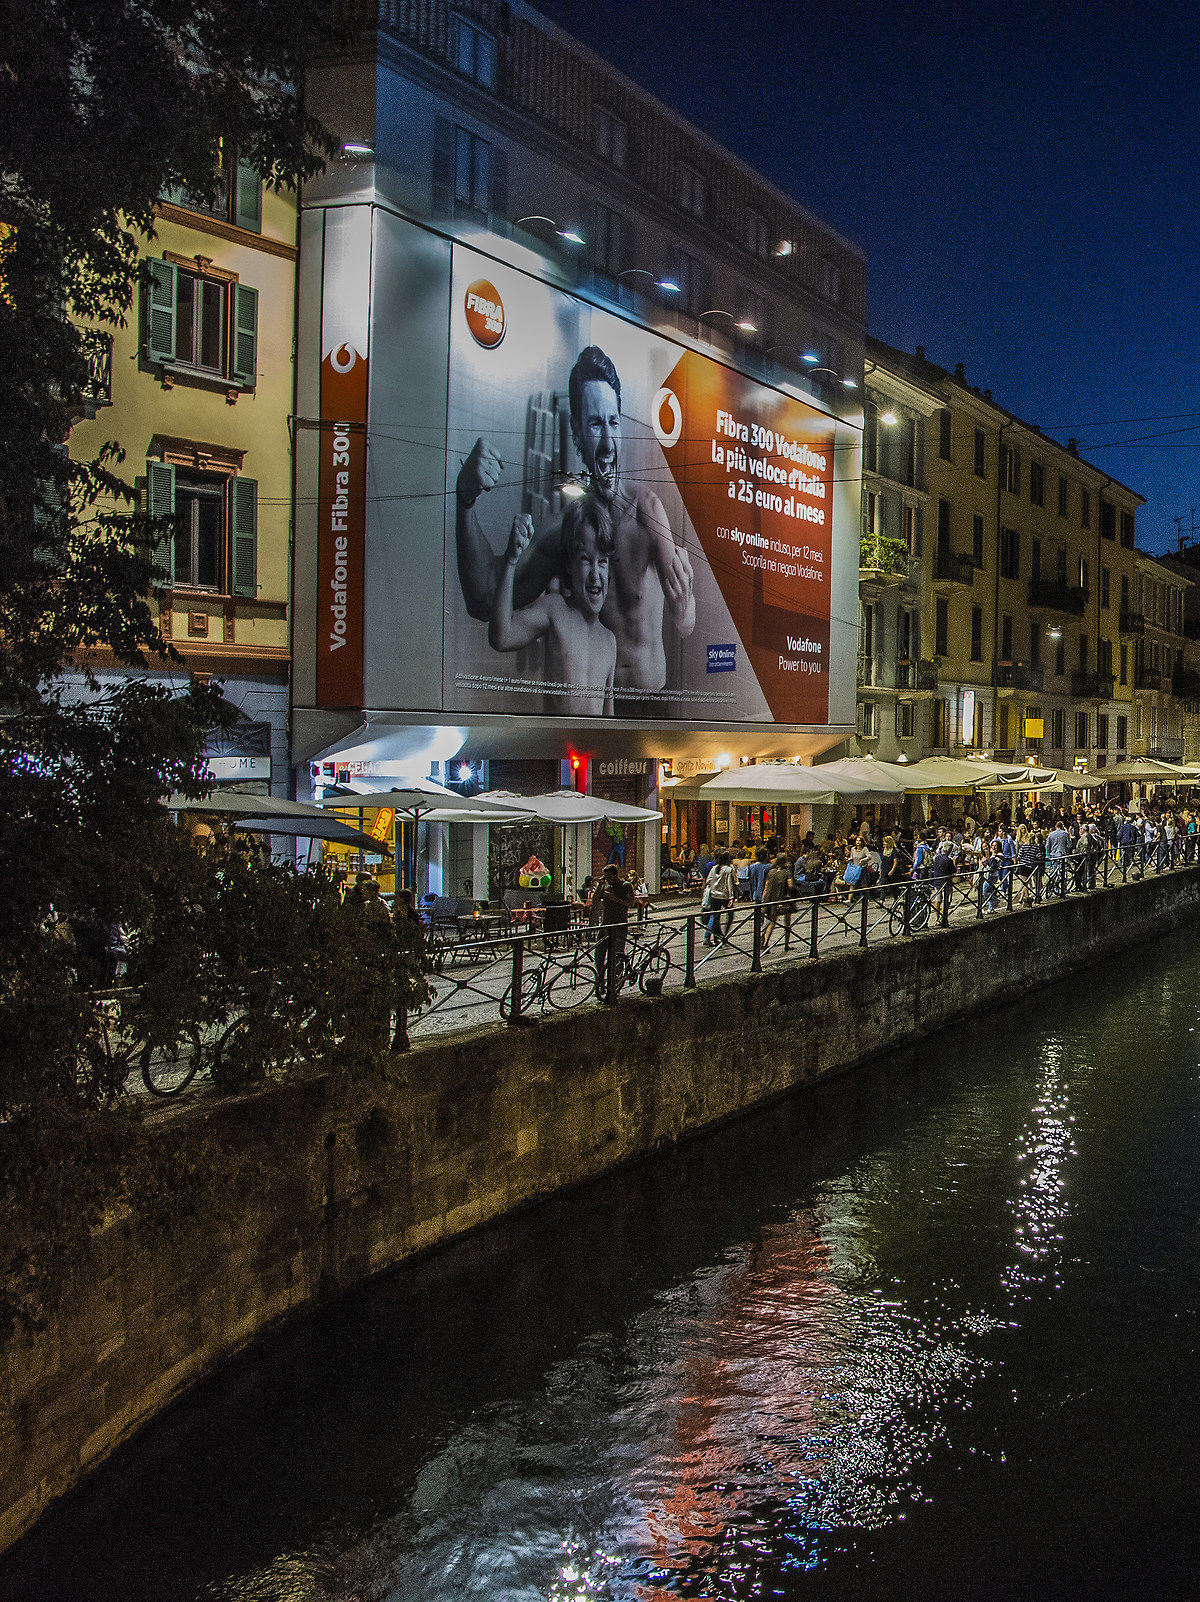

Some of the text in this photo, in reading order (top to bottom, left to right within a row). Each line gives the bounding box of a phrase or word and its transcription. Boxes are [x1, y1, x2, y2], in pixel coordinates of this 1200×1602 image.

[467, 292, 503, 323] FIBRA
[485, 317, 503, 334] 300
[716, 409, 827, 472] Fibra 300 Vodafone
[711, 439, 826, 499] la più veloce d'Italia
[727, 479, 825, 525] a 25 euro al mese
[330, 423, 350, 652] Vodafone Fibra 300
[716, 526, 730, 540] con
[730, 527, 745, 547] sky
[745, 533, 770, 550] online
[791, 545, 802, 559] per
[802, 546, 810, 560] 12
[777, 562, 797, 578] negozi
[708, 648, 719, 661] sky
[786, 635, 822, 654] Vodafone
[778, 655, 821, 676] Power to you
[217, 757, 256, 769] OME
[600, 758, 648, 775] coiffeur
